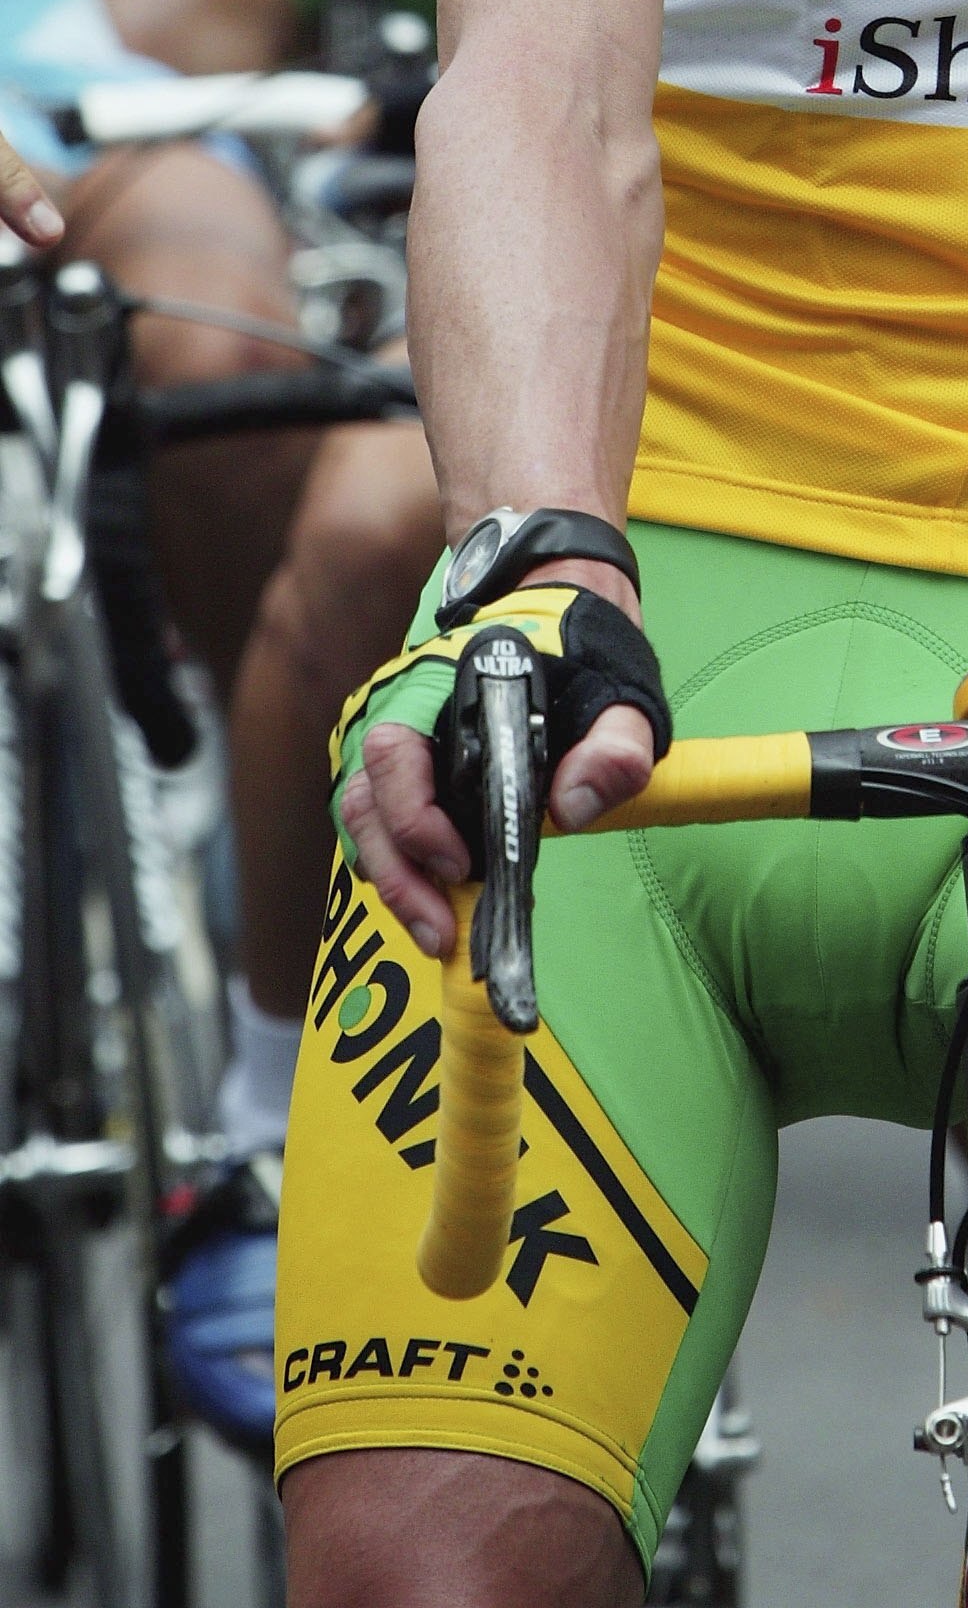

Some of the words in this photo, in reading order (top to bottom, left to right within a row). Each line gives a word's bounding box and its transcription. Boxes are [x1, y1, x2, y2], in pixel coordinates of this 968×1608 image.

[473, 656, 534, 676] ULTRA
[311, 859, 600, 1309] PHONK
[283, 1337, 491, 1393] CRAFT
